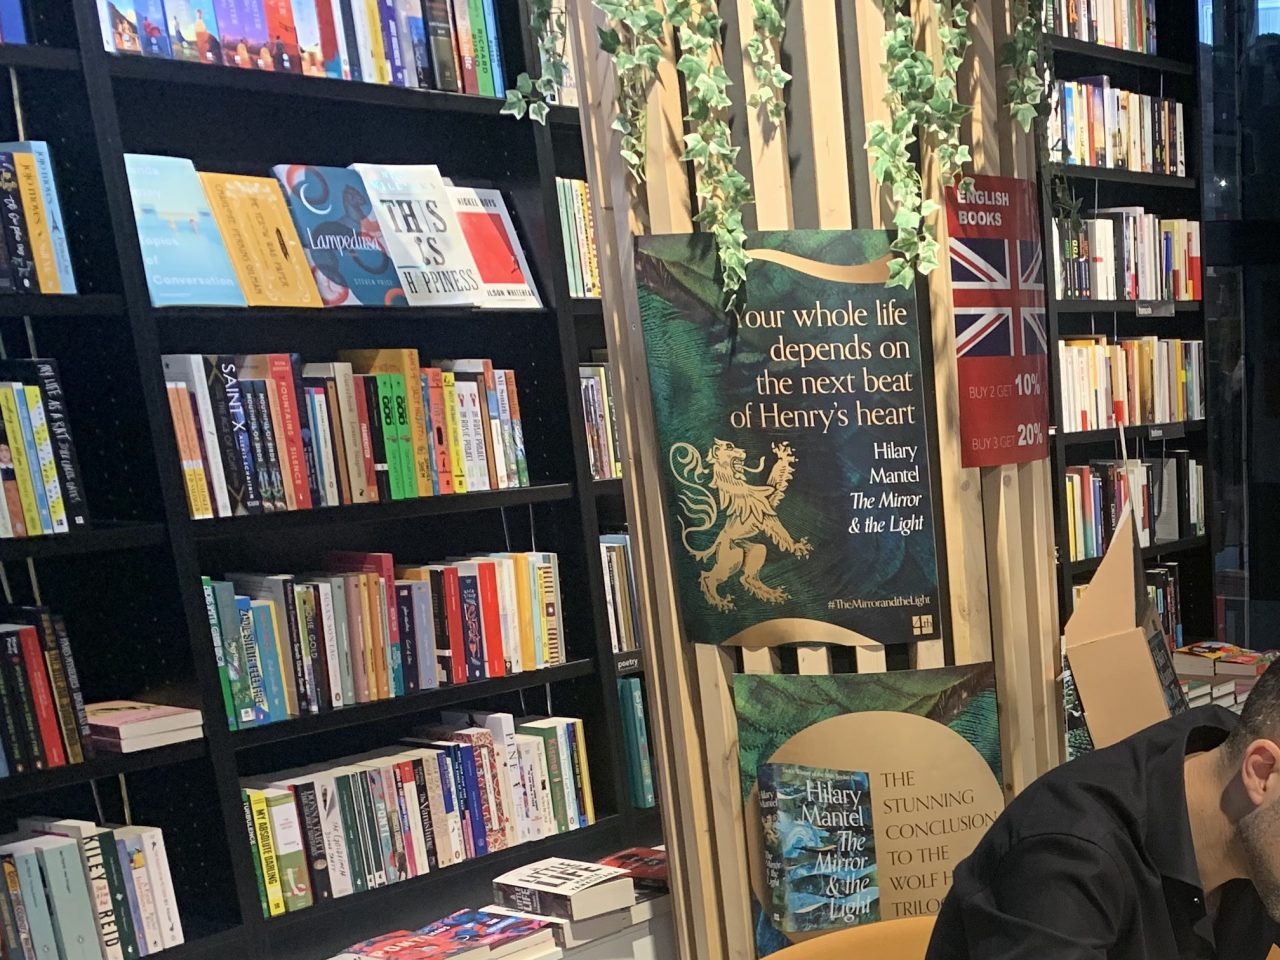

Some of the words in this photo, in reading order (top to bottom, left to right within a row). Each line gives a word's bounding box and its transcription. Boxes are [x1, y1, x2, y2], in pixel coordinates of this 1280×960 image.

[472, 33, 480, 68] RUSSO
[477, 28, 488, 74] RICHARD
[480, 198, 497, 208] BOYS
[958, 190, 1010, 206] ENGLISH
[379, 199, 448, 234] THIS
[958, 210, 1002, 226] BOOKS
[307, 227, 379, 257] Lampedusa
[414, 236, 446, 266] IS
[153, 274, 234, 287] Conversation
[736, 303, 785, 328] Your
[792, 301, 868, 327] whole
[876, 298, 908, 326] life
[770, 335, 873, 367] depends
[880, 341, 910, 359] on
[38, 364, 54, 376] MY
[756, 369, 793, 395] the
[801, 371, 855, 394] next
[863, 367, 914, 393] beat
[44, 378, 62, 399] LIFE
[222, 364, 244, 414] SAINT
[969, 386, 988, 399] BUY
[990, 384, 996, 398] 2
[998, 384, 1012, 398] GET
[1015, 372, 1040, 396] 10%
[48, 400, 62, 412] AS
[279, 381, 294, 436] FOUNTAINS
[382, 395, 392, 425] GOD
[396, 395, 406, 425] GOD
[499, 389, 507, 415] Smith
[232, 420, 246, 432] X
[246, 393, 257, 431] MOUTHFUL
[254, 442, 263, 462] BIRDS
[259, 393, 270, 431] MOUTHFUL
[267, 442, 275, 462] BIRDS
[461, 419, 470, 438] ROSIE
[472, 419, 481, 438] ROSIE
[730, 402, 753, 428] of
[759, 402, 849, 434] Henry's
[856, 400, 916, 426] heart
[52, 419, 72, 445] RAT
[972, 436, 992, 450] BUY
[992, 436, 998, 448] 3
[1000, 434, 1016, 448] GET
[1018, 422, 1043, 446] 20%
[874, 442, 917, 462] Hilary
[289, 447, 301, 485] SILENCE
[870, 465, 920, 484] Mantel
[850, 492, 875, 510] The
[878, 492, 922, 509] Mirror
[848, 516, 860, 534] &
[864, 516, 886, 533] the
[890, 514, 924, 536] Light
[828, 596, 930, 610] #TheMirrorandtheLight
[309, 634, 318, 658] GOLD
[247, 665, 260, 685] FEEL
[618, 656, 638, 670] poetry
[251, 686, 265, 706] FREE
[506, 732, 519, 769] PINE
[546, 738, 558, 772] Kismet
[880, 770, 916, 788] THE
[306, 790, 319, 823] DONNA
[806, 780, 862, 810] Hilary
[884, 789, 974, 815] STUNNING
[244, 802, 256, 846] TURBULENCE
[255, 808, 264, 819] MY
[376, 802, 389, 836] PONTI
[421, 802, 434, 849] Vanishing
[801, 804, 864, 828] Mantel
[885, 810, 998, 841] CONCLUSION
[258, 820, 272, 854] ABSOLUTE
[312, 825, 325, 854] TARTT
[838, 830, 866, 852] The
[82, 836, 107, 881] KILEY
[264, 853, 278, 884] DARLING
[814, 852, 868, 874] Mirror
[888, 850, 912, 866] TO
[916, 845, 950, 864] THE
[518, 862, 576, 883] LITTLE
[534, 867, 602, 888] LIFE
[826, 875, 839, 896] &
[844, 875, 870, 894] the
[889, 871, 944, 892] WOLF
[514, 888, 524, 911] LITTLE
[520, 888, 533, 912] LIFE
[830, 895, 870, 922] Light
[98, 909, 120, 948] REID
[369, 935, 434, 959] PONTI
